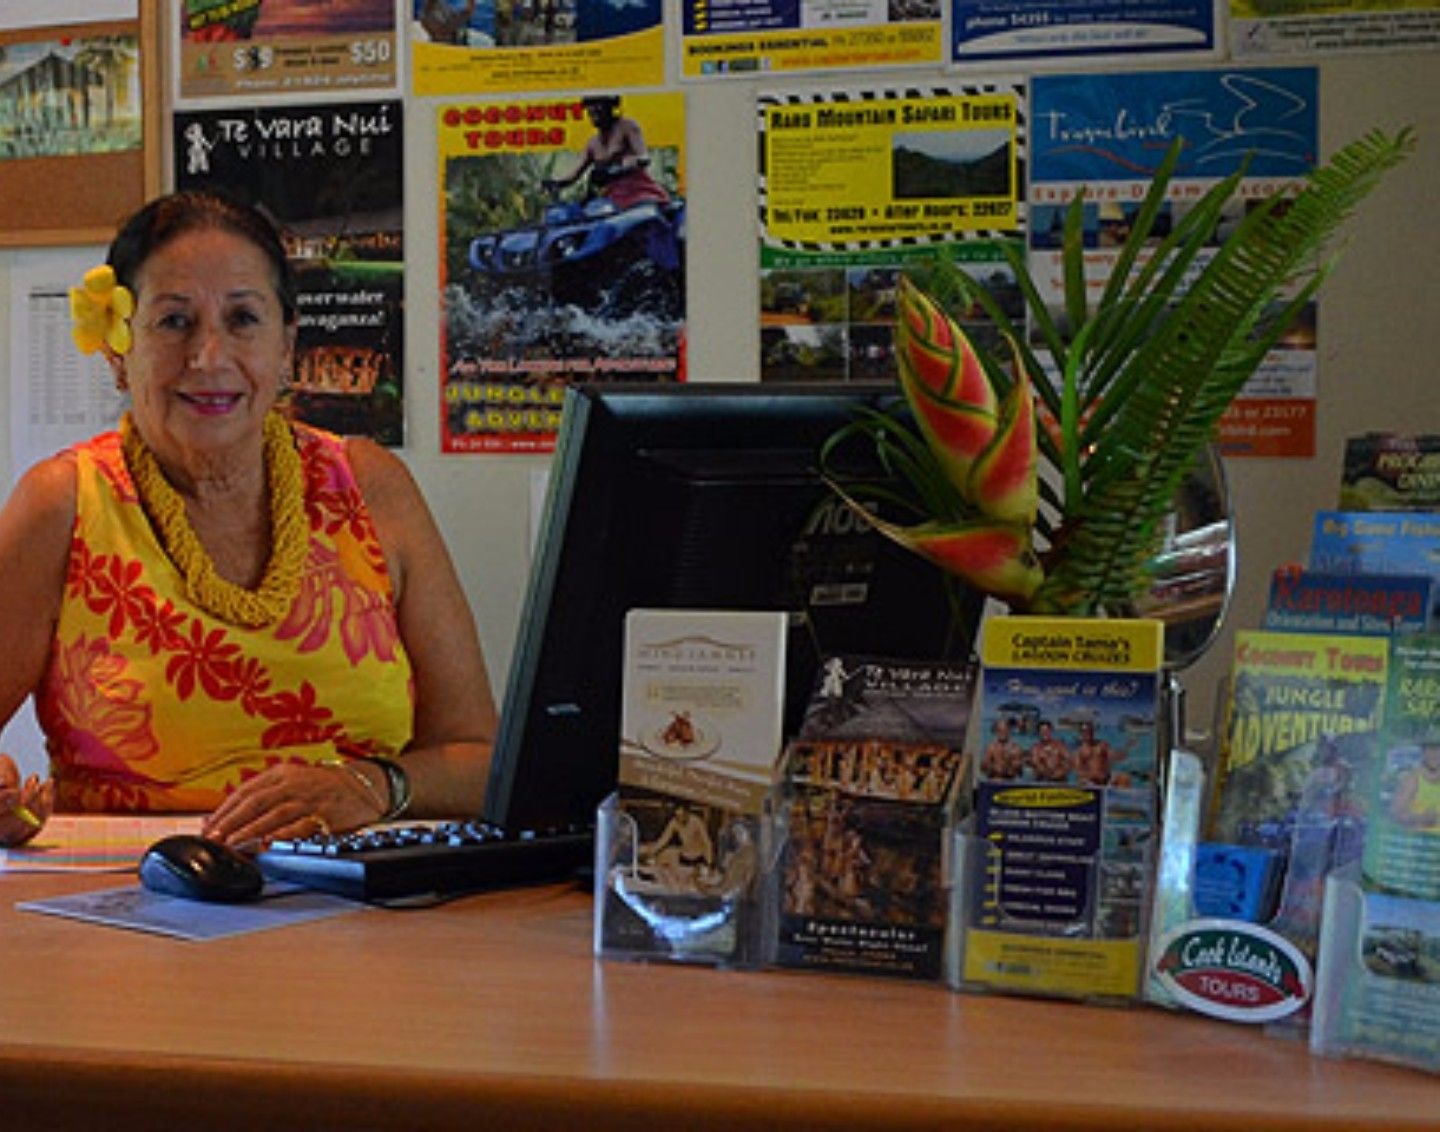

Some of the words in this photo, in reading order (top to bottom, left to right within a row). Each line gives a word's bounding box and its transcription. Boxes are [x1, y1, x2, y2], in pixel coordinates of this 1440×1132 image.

[331, 104, 394, 136] Nui
[443, 101, 586, 128] COCONUT
[236, 137, 372, 159] VILLAGE
[465, 127, 565, 149] TOURS
[1266, 687, 1346, 709] JUNGLE
[1198, 975, 1260, 1002] TOURS
